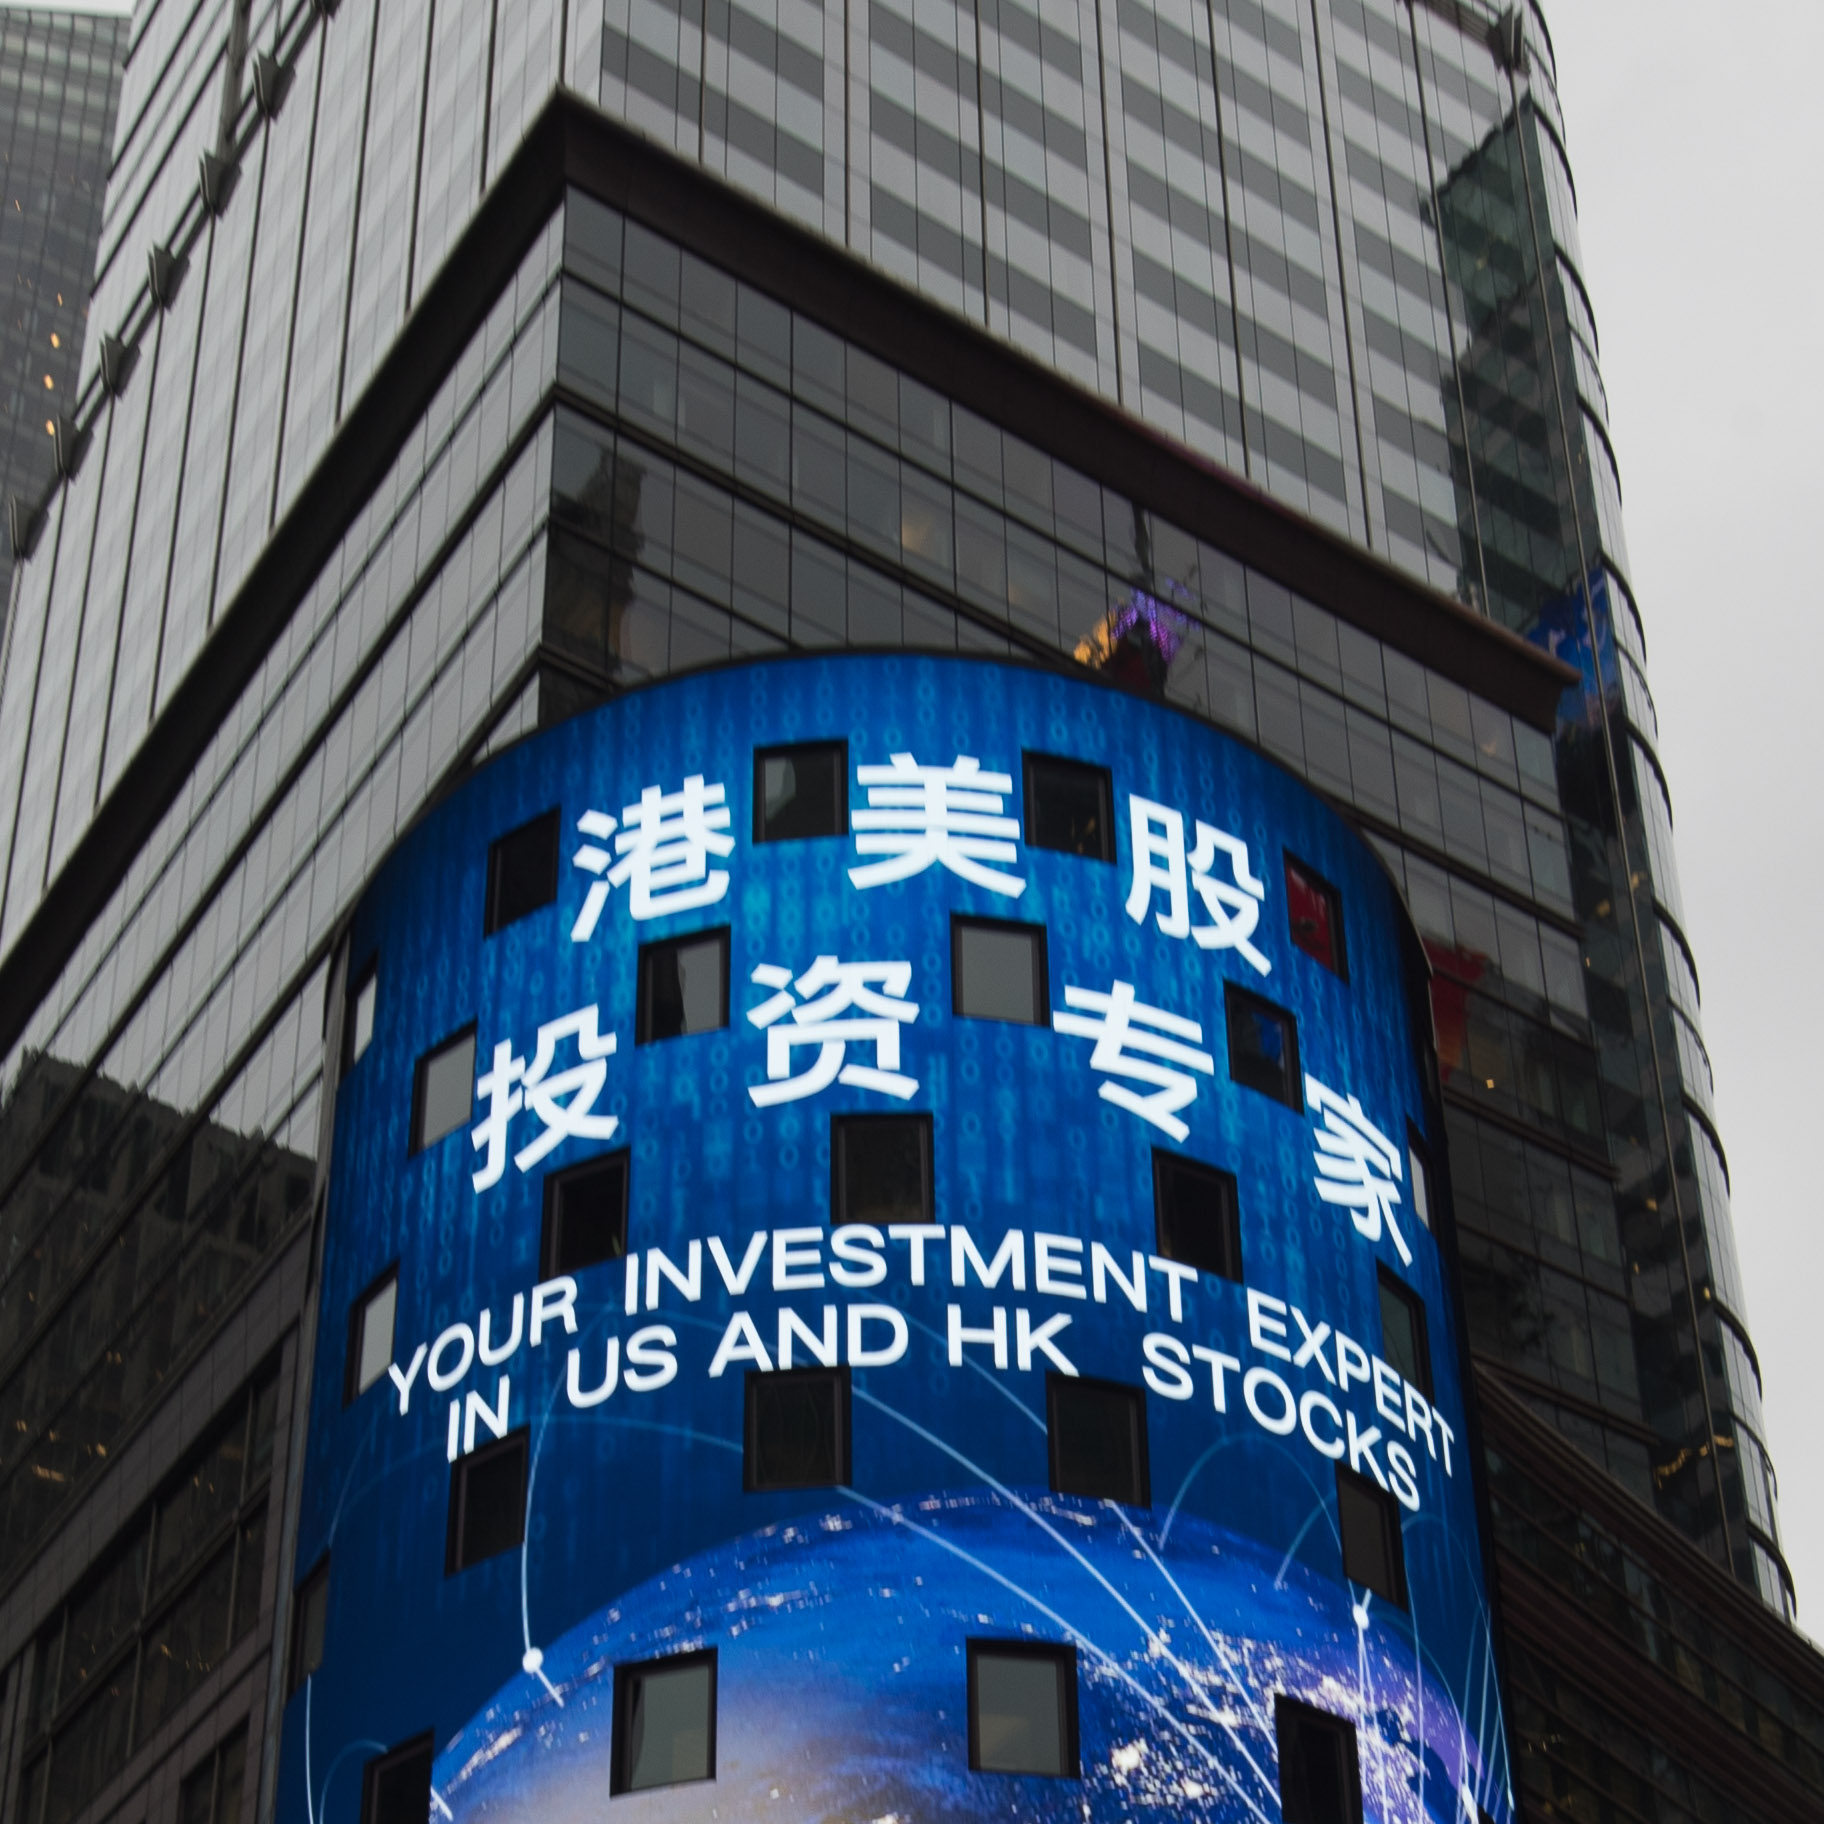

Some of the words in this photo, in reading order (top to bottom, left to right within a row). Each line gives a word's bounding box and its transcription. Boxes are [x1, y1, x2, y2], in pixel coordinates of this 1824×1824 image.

[570, 750, 1272, 977] 港美股
[471, 953, 1414, 1266] 投资专家
[387, 1276, 579, 1418] YOUR
[625, 1222, 1198, 1324] INVESTMENT
[1247, 1290, 1457, 1479] EXPERT
[446, 1375, 510, 1462] IN
[566, 1321, 680, 1409] US
[709, 1304, 910, 1378] AND
[947, 1304, 1080, 1377] HK
[1141, 1331, 1424, 1514] STOCKS
